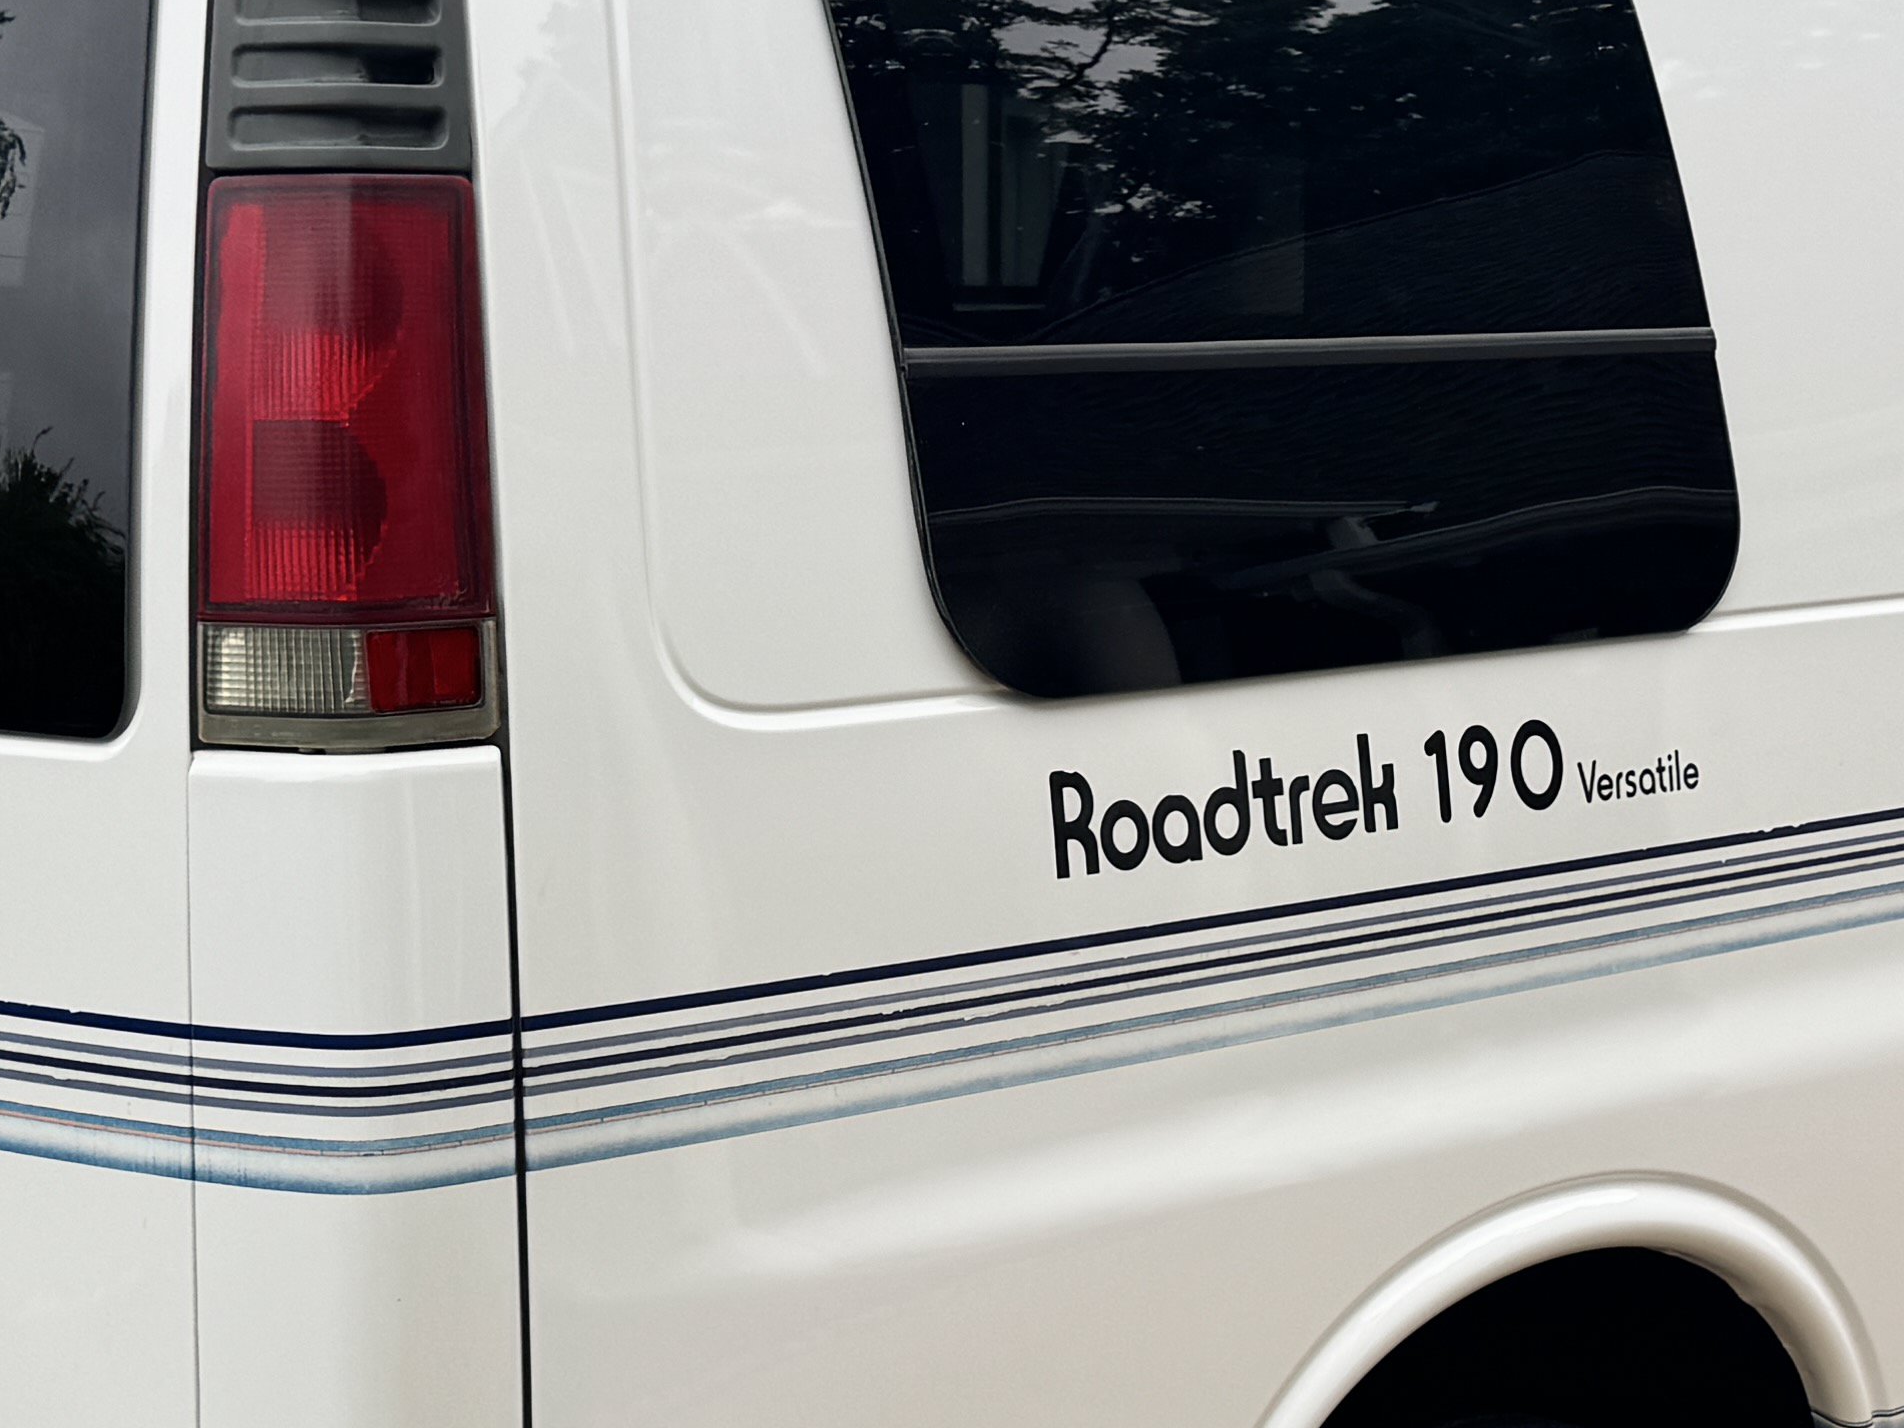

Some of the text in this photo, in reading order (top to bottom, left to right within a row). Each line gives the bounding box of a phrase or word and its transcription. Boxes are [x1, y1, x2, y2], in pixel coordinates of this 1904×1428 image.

[1049, 719, 1700, 879] Roadtrek 190 Versatile
